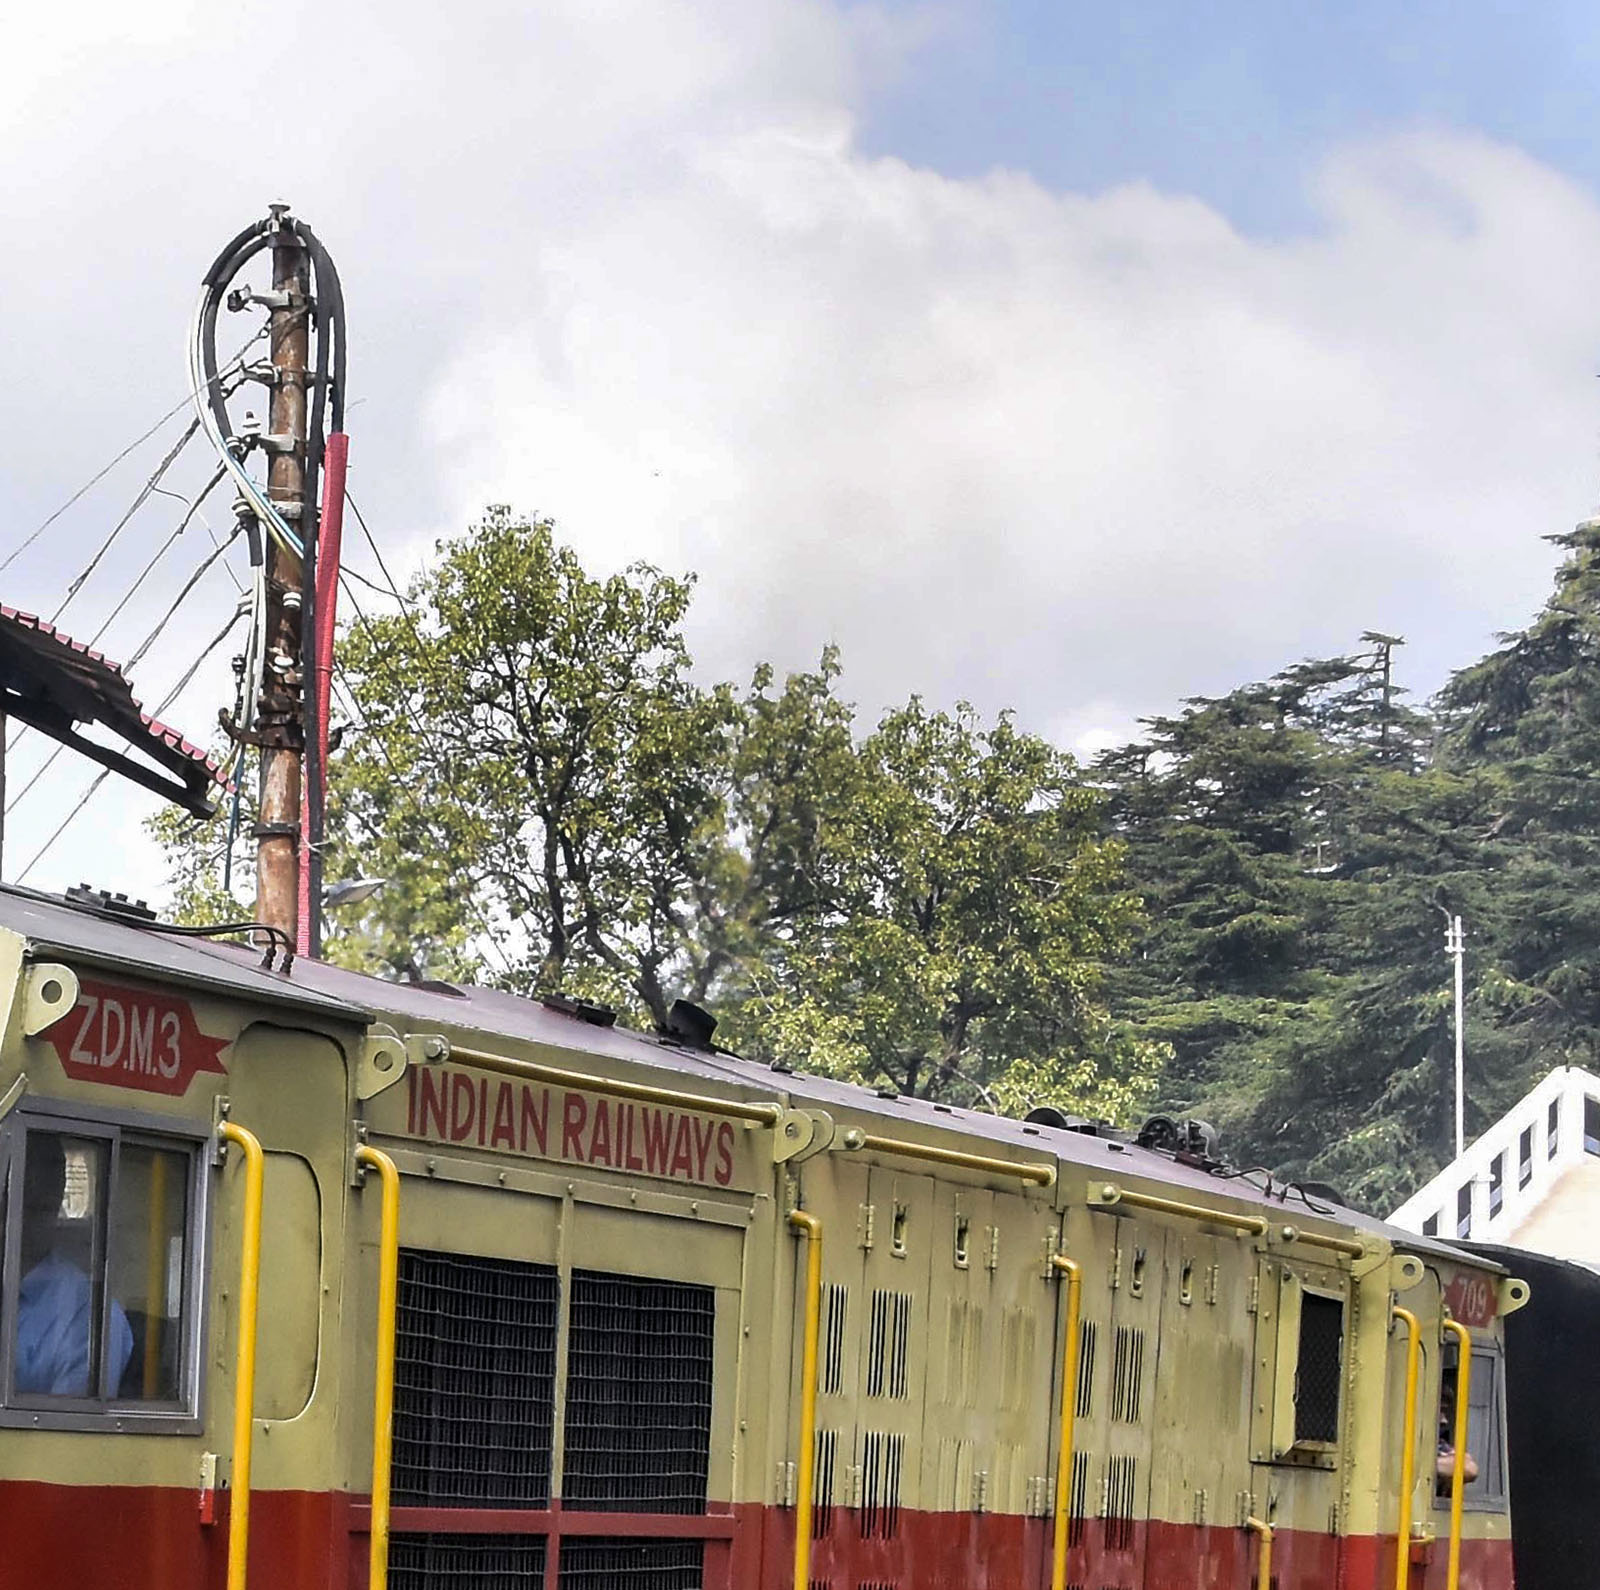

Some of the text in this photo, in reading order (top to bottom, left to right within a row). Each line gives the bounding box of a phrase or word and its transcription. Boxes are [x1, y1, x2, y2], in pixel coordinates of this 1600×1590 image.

[69, 993, 181, 1079] Z.D.M.3
[407, 1064, 736, 1187] INDIAN RAILWAYS
[1457, 1276, 1488, 1321] 709
